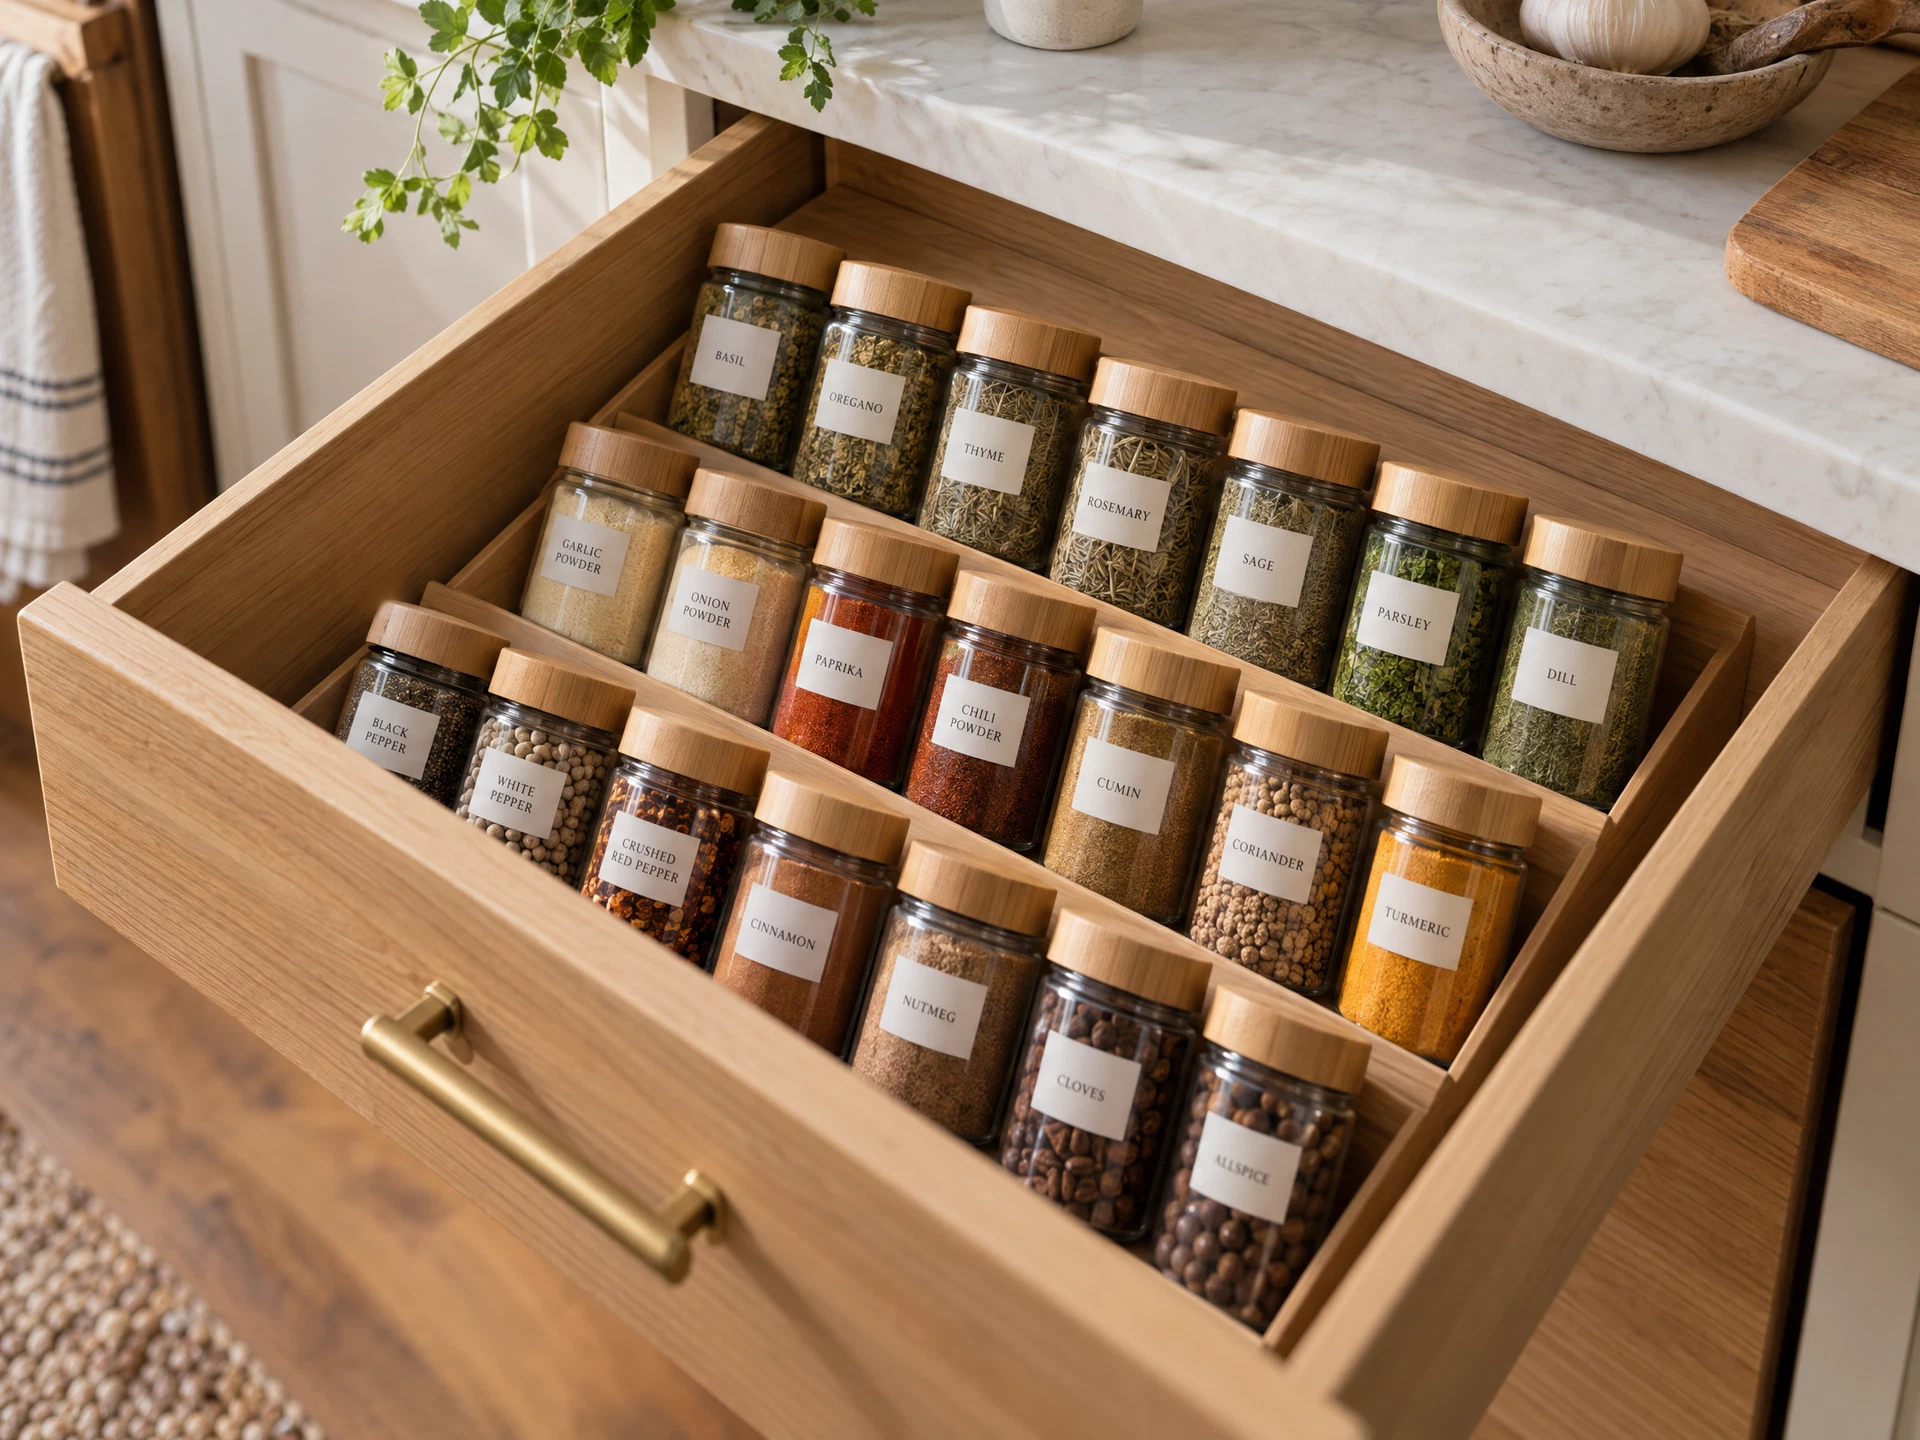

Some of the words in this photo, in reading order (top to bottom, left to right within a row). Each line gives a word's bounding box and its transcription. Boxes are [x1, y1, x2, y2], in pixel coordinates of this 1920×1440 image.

[715, 350, 745, 367] BASIL
[829, 391, 883, 414] OREGANO
[964, 442, 1005, 463] THYME
[1087, 495, 1151, 522] ROSEMARY
[562, 538, 603, 559] GARLIC
[555, 551, 602, 575] POWDER
[1242, 553, 1275, 572] SAGE
[690, 591, 731, 612] ONION
[682, 604, 731, 629] POWDER
[1377, 606, 1432, 631] PARSLEY
[814, 653, 863, 678] PAPRIKA
[1546, 667, 1577, 687] DILL
[961, 704, 996, 724] CHILI
[371, 717, 409, 739] BLACK
[949, 716, 1002, 743] POWDER
[364, 730, 407, 755] PEPPER
[497, 774, 536, 798] WHITE
[1096, 776, 1142, 800] CUMIN
[489, 789, 533, 814] PEPPER
[622, 837, 676, 865] CRUSHED
[1232, 838, 1305, 872] CORIANDER
[610, 849, 633, 867] RED
[634, 859, 679, 884] PEPPER
[750, 917, 816, 951] CINNAMON
[1385, 906, 1451, 939] TURMERIC
[902, 994, 957, 1024] NUTMEG
[1057, 1074, 1105, 1102] CLOVES
[1213, 1154, 1270, 1186] ALLSPICE
